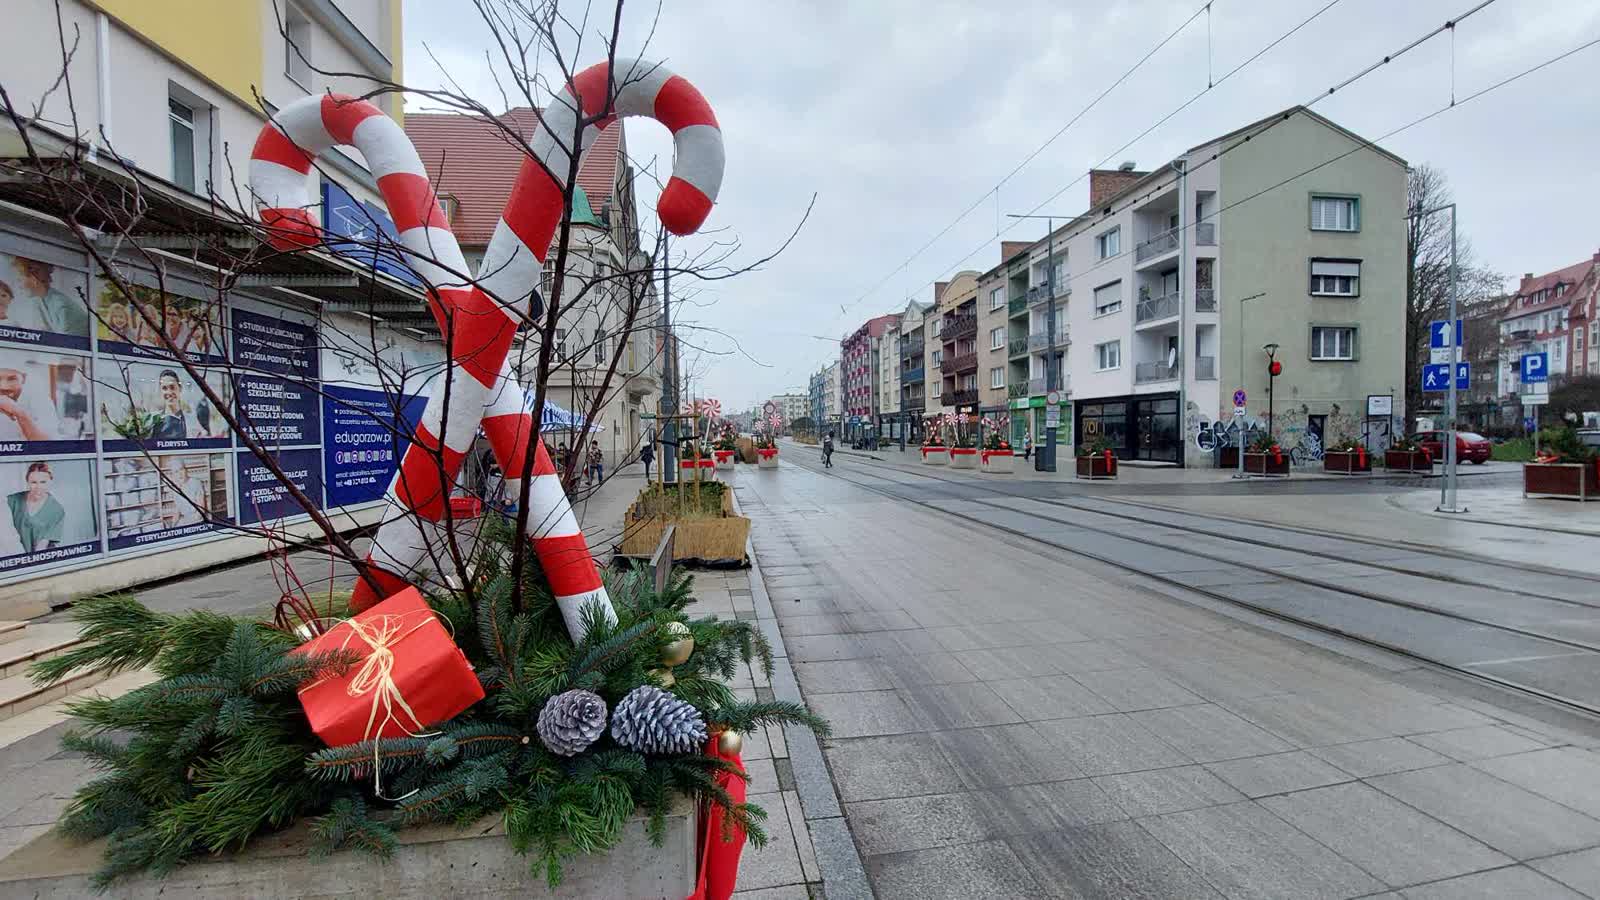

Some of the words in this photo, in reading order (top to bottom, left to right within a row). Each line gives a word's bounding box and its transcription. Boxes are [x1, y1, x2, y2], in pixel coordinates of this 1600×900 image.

[243, 322, 266, 334] STUDIA
[1526, 355, 1542, 375] P
[157, 440, 189, 448] FLORYSTA
[335, 431, 392, 446] edugorzow.pl
[135, 528, 183, 543] STERYLIZATOR
